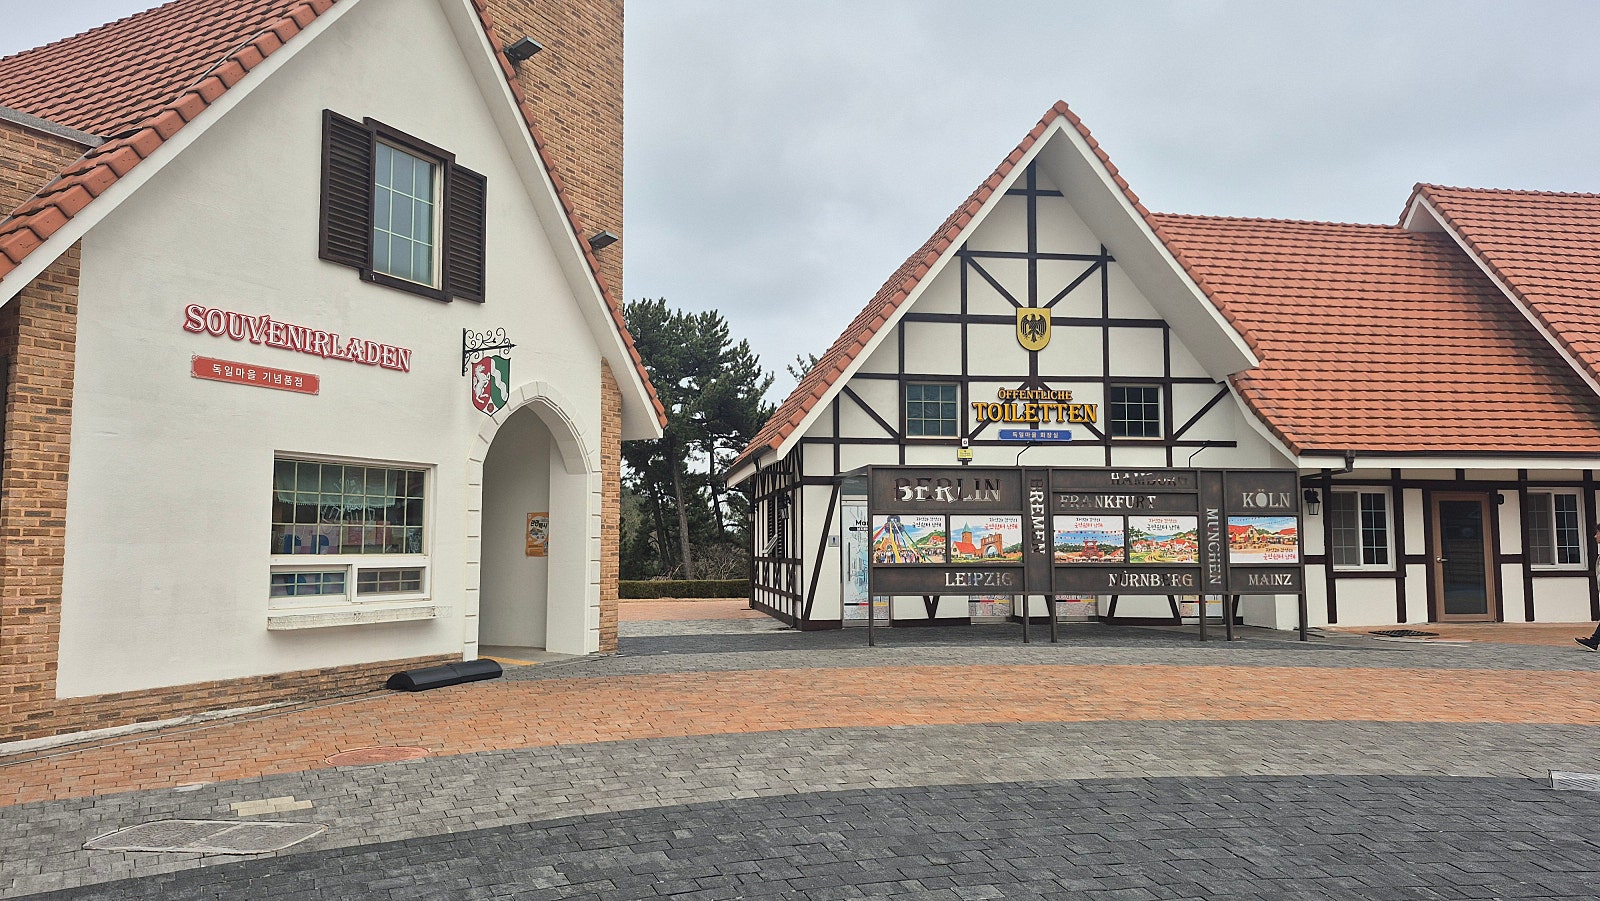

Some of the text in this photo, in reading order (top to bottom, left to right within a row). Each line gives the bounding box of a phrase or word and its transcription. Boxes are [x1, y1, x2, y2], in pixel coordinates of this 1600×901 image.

[183, 303, 412, 373] SOUVENIRLADEN
[212, 364, 303, 387] 독일마을 기념품점
[997, 387, 1073, 401] ÖFFENTLICHE
[971, 402, 1098, 423] TOILETTEN
[894, 478, 1001, 503] BERLIN
[1242, 489, 1290, 508] KÖLN
[1059, 494, 1157, 509] FRANKFURT
[1029, 478, 1046, 555] BREMEN
[944, 572, 1013, 587] LEIPZIG
[1108, 570, 1193, 587] NÜRNBERG
[1248, 573, 1292, 586] MAINZ
